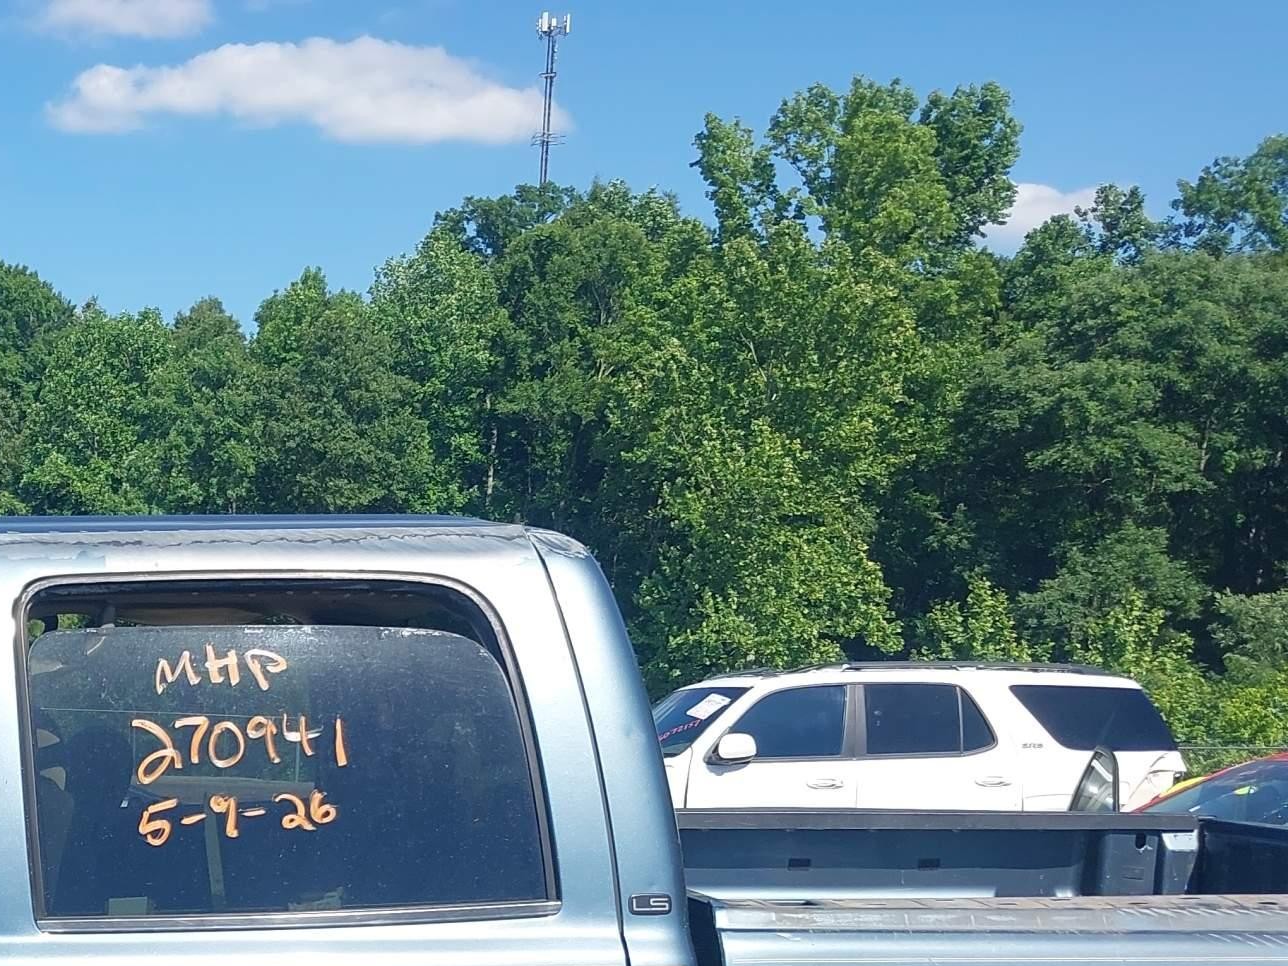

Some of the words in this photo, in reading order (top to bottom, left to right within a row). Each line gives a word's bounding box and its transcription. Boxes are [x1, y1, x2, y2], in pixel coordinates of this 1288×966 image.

[156, 642, 288, 695] MHP
[131, 711, 349, 785] 270941
[138, 789, 338, 846] 5-9-26
[632, 897, 669, 911] LS
